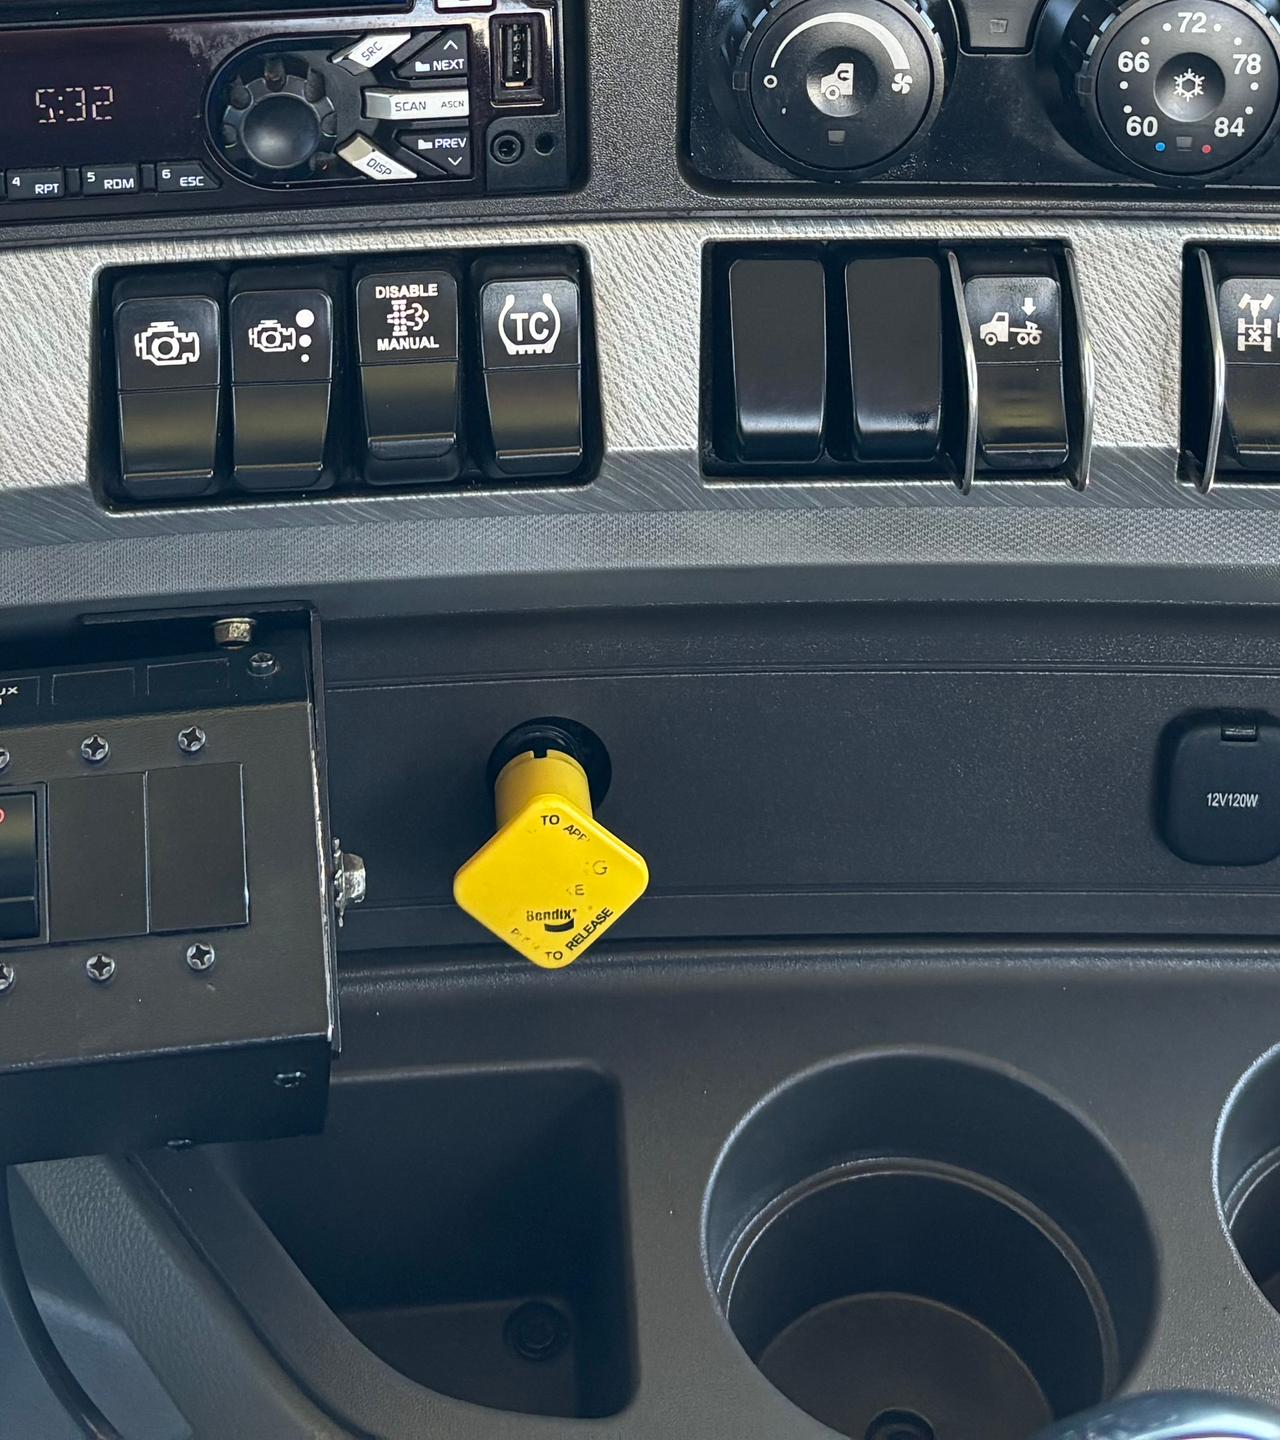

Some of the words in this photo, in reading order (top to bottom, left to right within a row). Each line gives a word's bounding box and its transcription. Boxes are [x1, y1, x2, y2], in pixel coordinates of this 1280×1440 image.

[1177, 12, 1207, 34] 72
[361, 40, 384, 62] SRC
[432, 58, 464, 72] NEXT
[1117, 50, 1150, 73] 66
[1232, 53, 1262, 75] 78
[35, 85, 114, 124] 5:32
[394, 98, 427, 112] SCAN
[1125, 116, 1159, 138] 60
[1213, 117, 1245, 138] 84
[434, 136, 467, 150] PREV
[365, 157, 393, 177] DISP
[11, 176, 21, 187] 4
[35, 183, 60, 195] RPT
[87, 171, 96, 182] 5
[103, 178, 135, 190] RDM
[161, 168, 171, 179] 6
[179, 176, 205, 187] ESC
[375, 283, 438, 299] DISABLE
[509, 312, 550, 342] TC
[376, 334, 440, 352] MANUAL
[1206, 792, 1259, 808] 12V120W
[540, 814, 560, 826] TO
[526, 908, 572, 921] Bendix
[545, 950, 563, 960] TO
[565, 907, 614, 951] RELEASE
